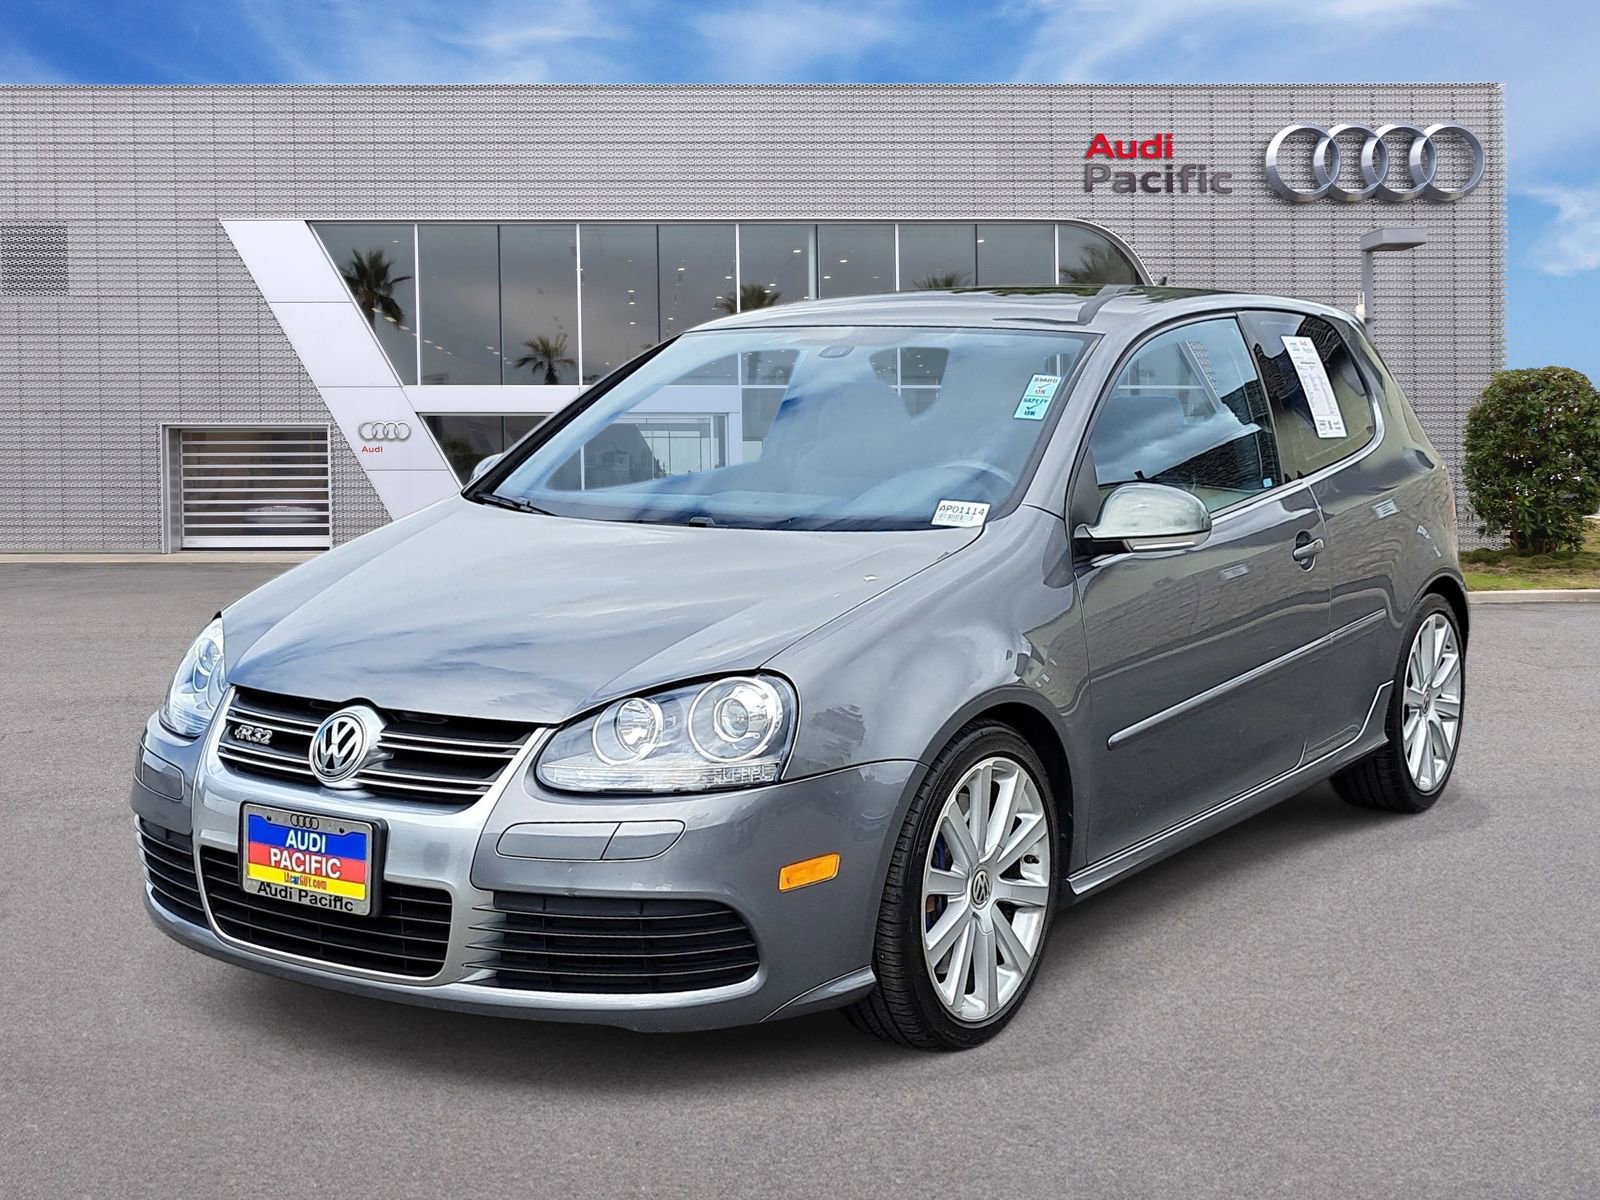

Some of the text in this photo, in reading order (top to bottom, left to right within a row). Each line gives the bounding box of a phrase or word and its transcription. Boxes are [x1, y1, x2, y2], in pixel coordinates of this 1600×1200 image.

[1084, 133, 1174, 159] Audi
[1084, 163, 1233, 194] Pacific
[234, 724, 273, 745] R32
[285, 829, 326, 854] AUDI
[269, 847, 342, 878] PACIFIC
[257, 881, 354, 912] Audi Pacific
